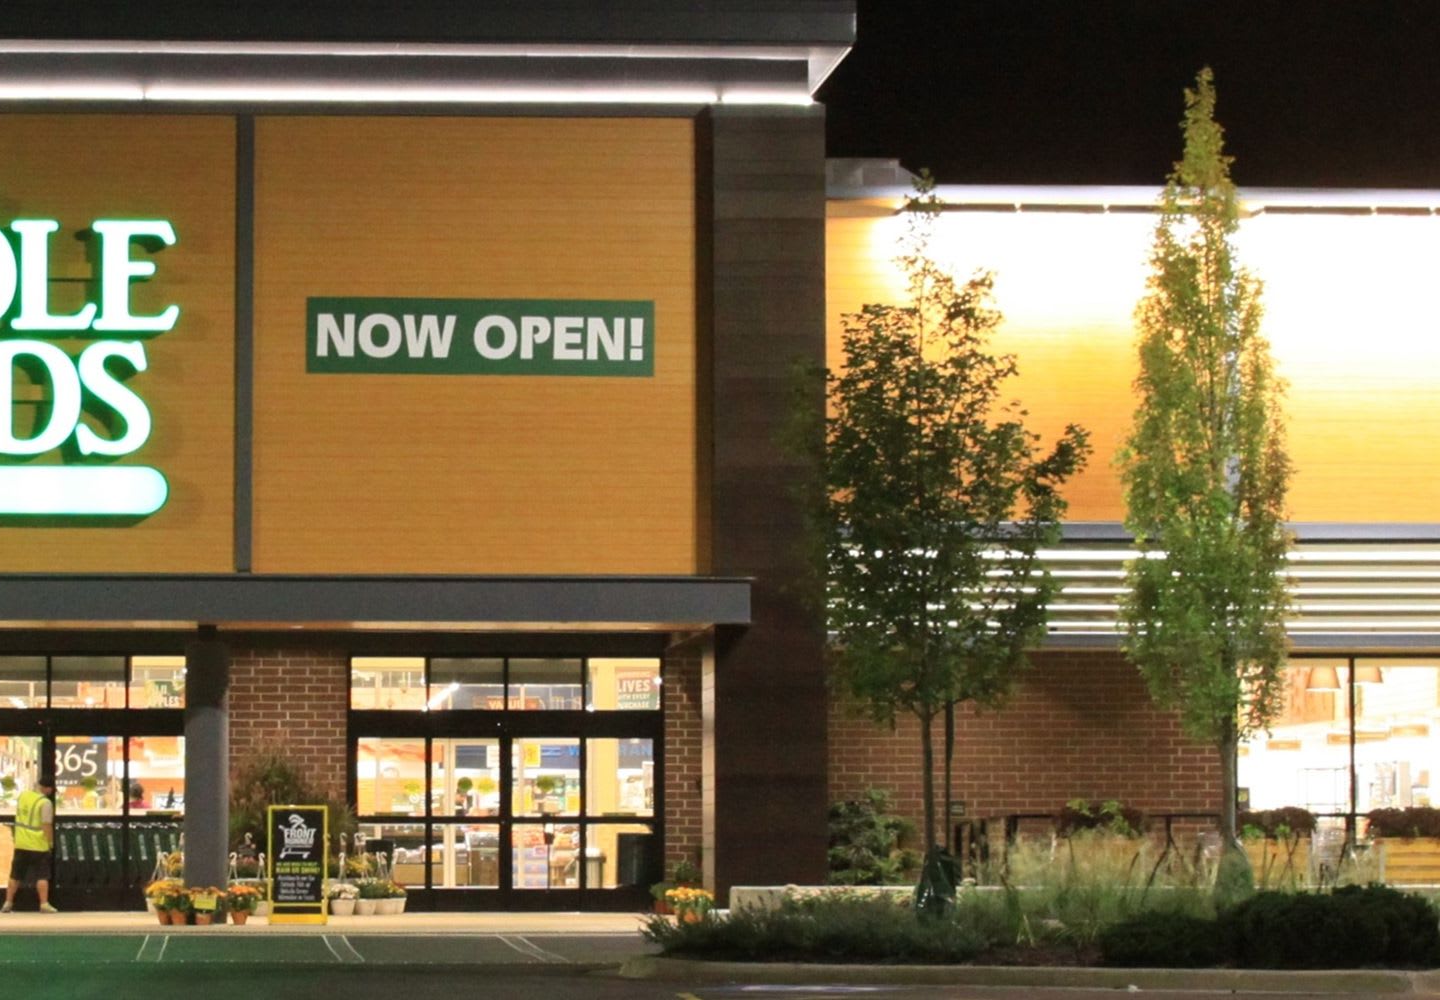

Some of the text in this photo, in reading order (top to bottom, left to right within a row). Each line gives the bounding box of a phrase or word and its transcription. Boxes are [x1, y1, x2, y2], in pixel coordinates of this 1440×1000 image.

[316, 312, 645, 362] NOW OPEN!
[55, 745, 98, 777] 365
[284, 828, 317, 840] FRONT
